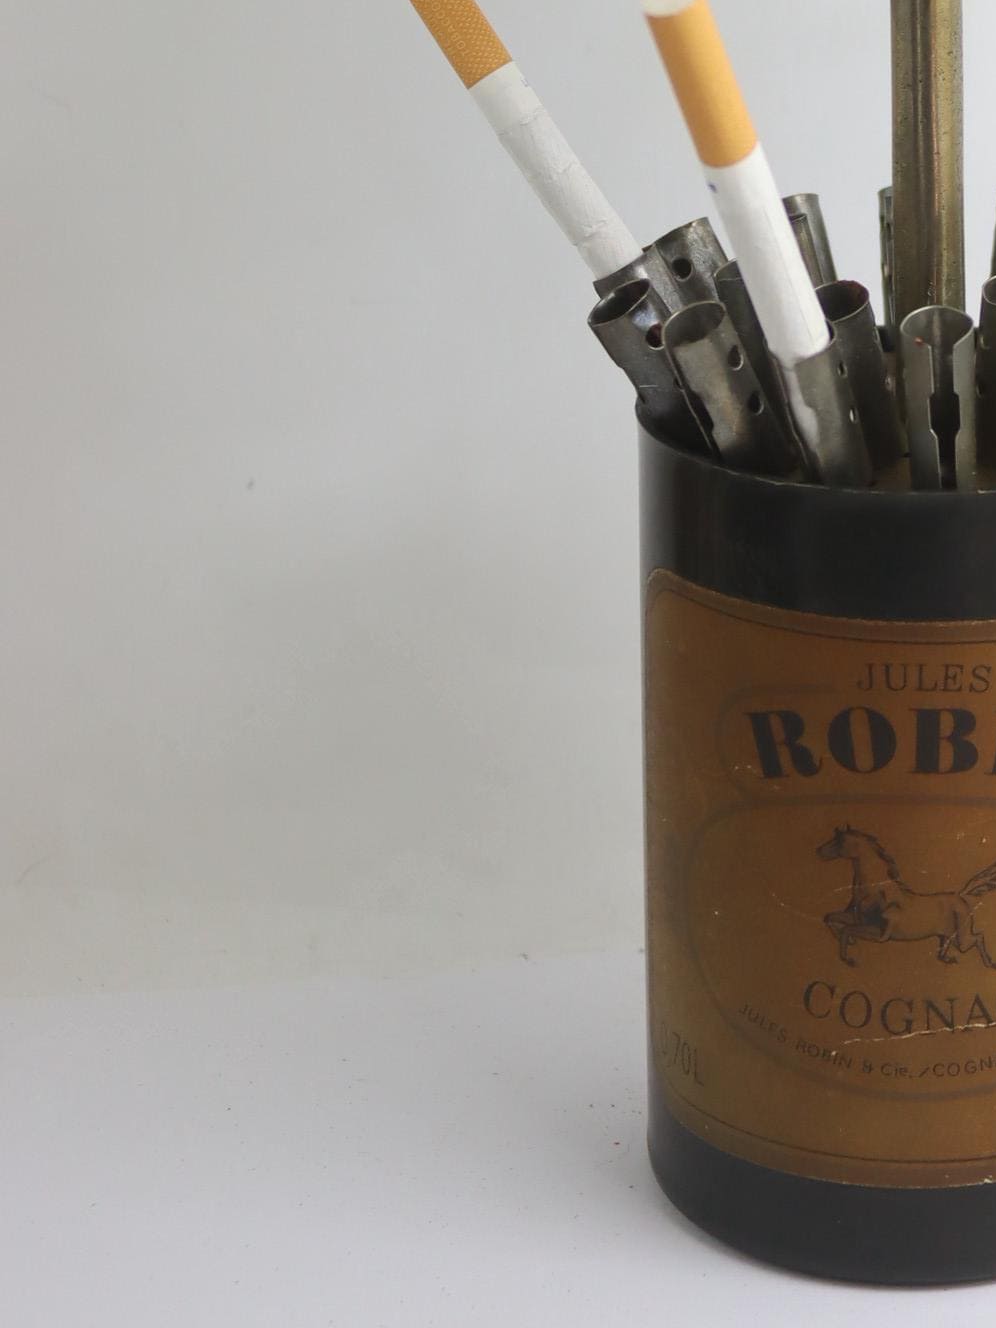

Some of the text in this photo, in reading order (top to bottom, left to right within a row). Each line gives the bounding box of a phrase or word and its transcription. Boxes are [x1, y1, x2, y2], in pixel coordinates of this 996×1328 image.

[857, 663, 992, 693] JULES
[738, 1003, 787, 1043] JULES
[796, 1037, 853, 1069] ROBIN
